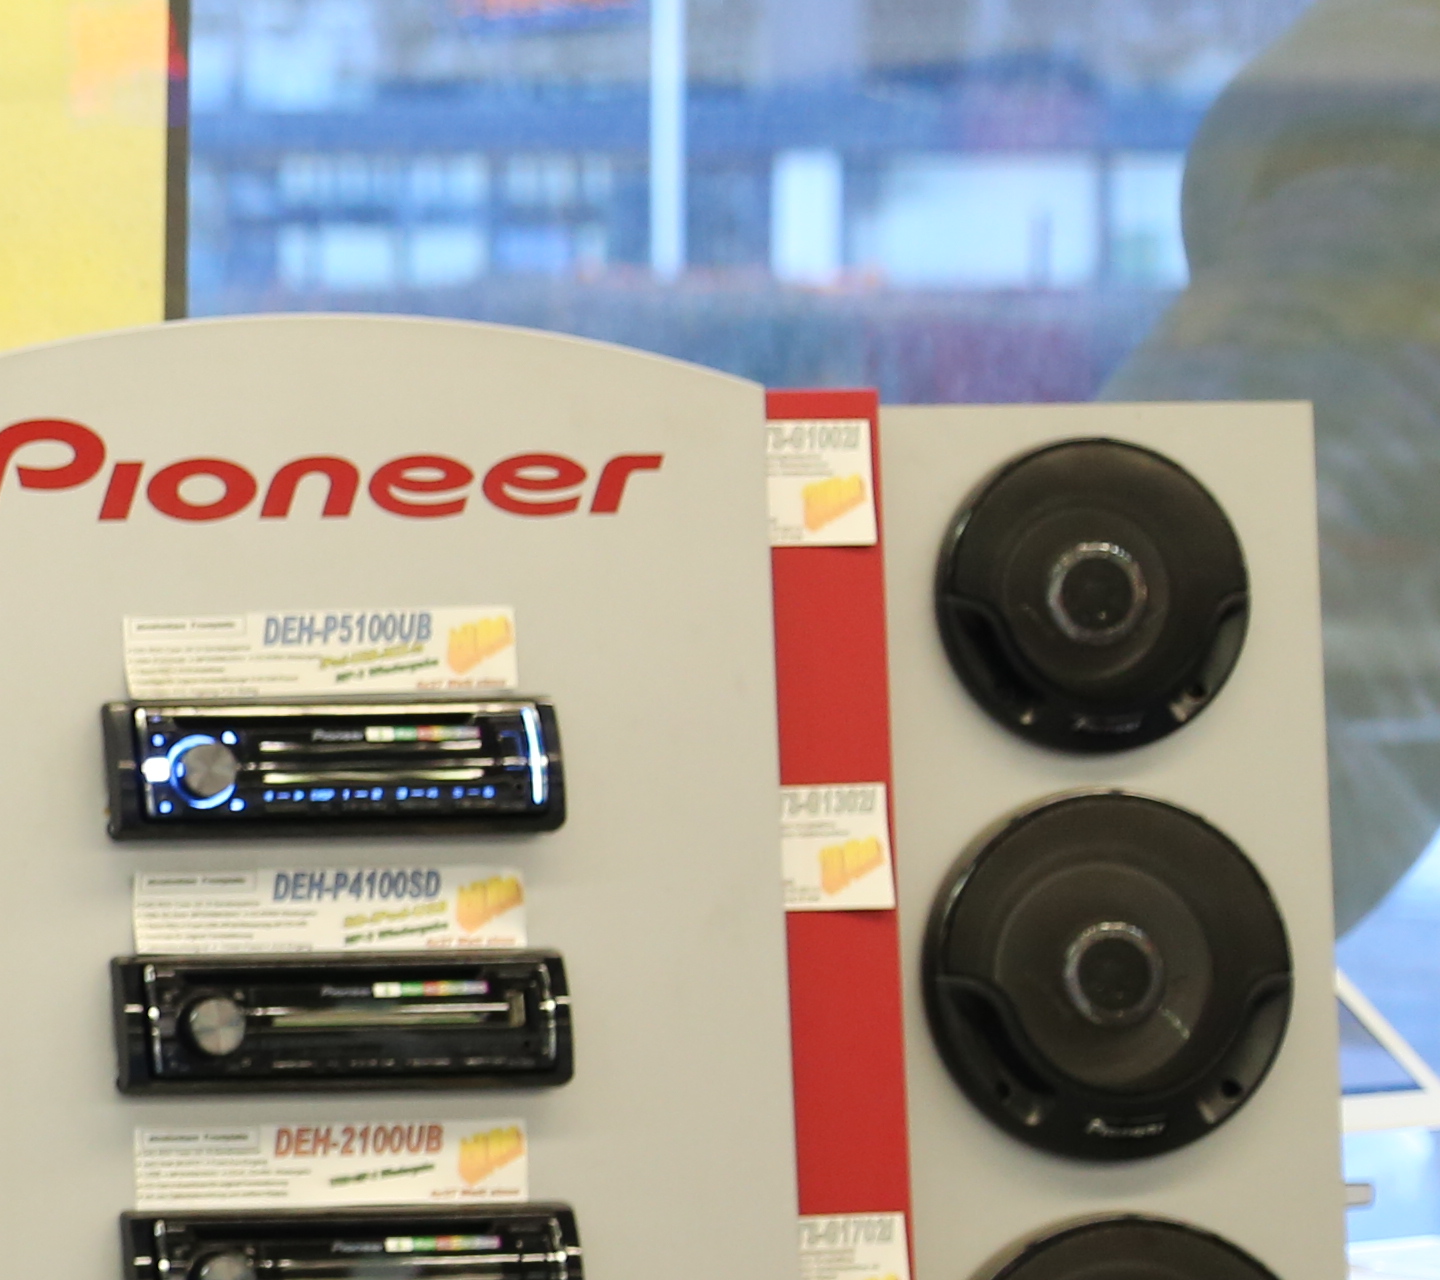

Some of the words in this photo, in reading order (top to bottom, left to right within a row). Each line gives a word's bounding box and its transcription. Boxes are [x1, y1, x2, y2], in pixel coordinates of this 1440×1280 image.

[263, 612, 432, 646] DEH-P5100UB
[273, 869, 442, 903] DEH-P4100SD
[273, 1124, 444, 1157] DEH-2100UB
